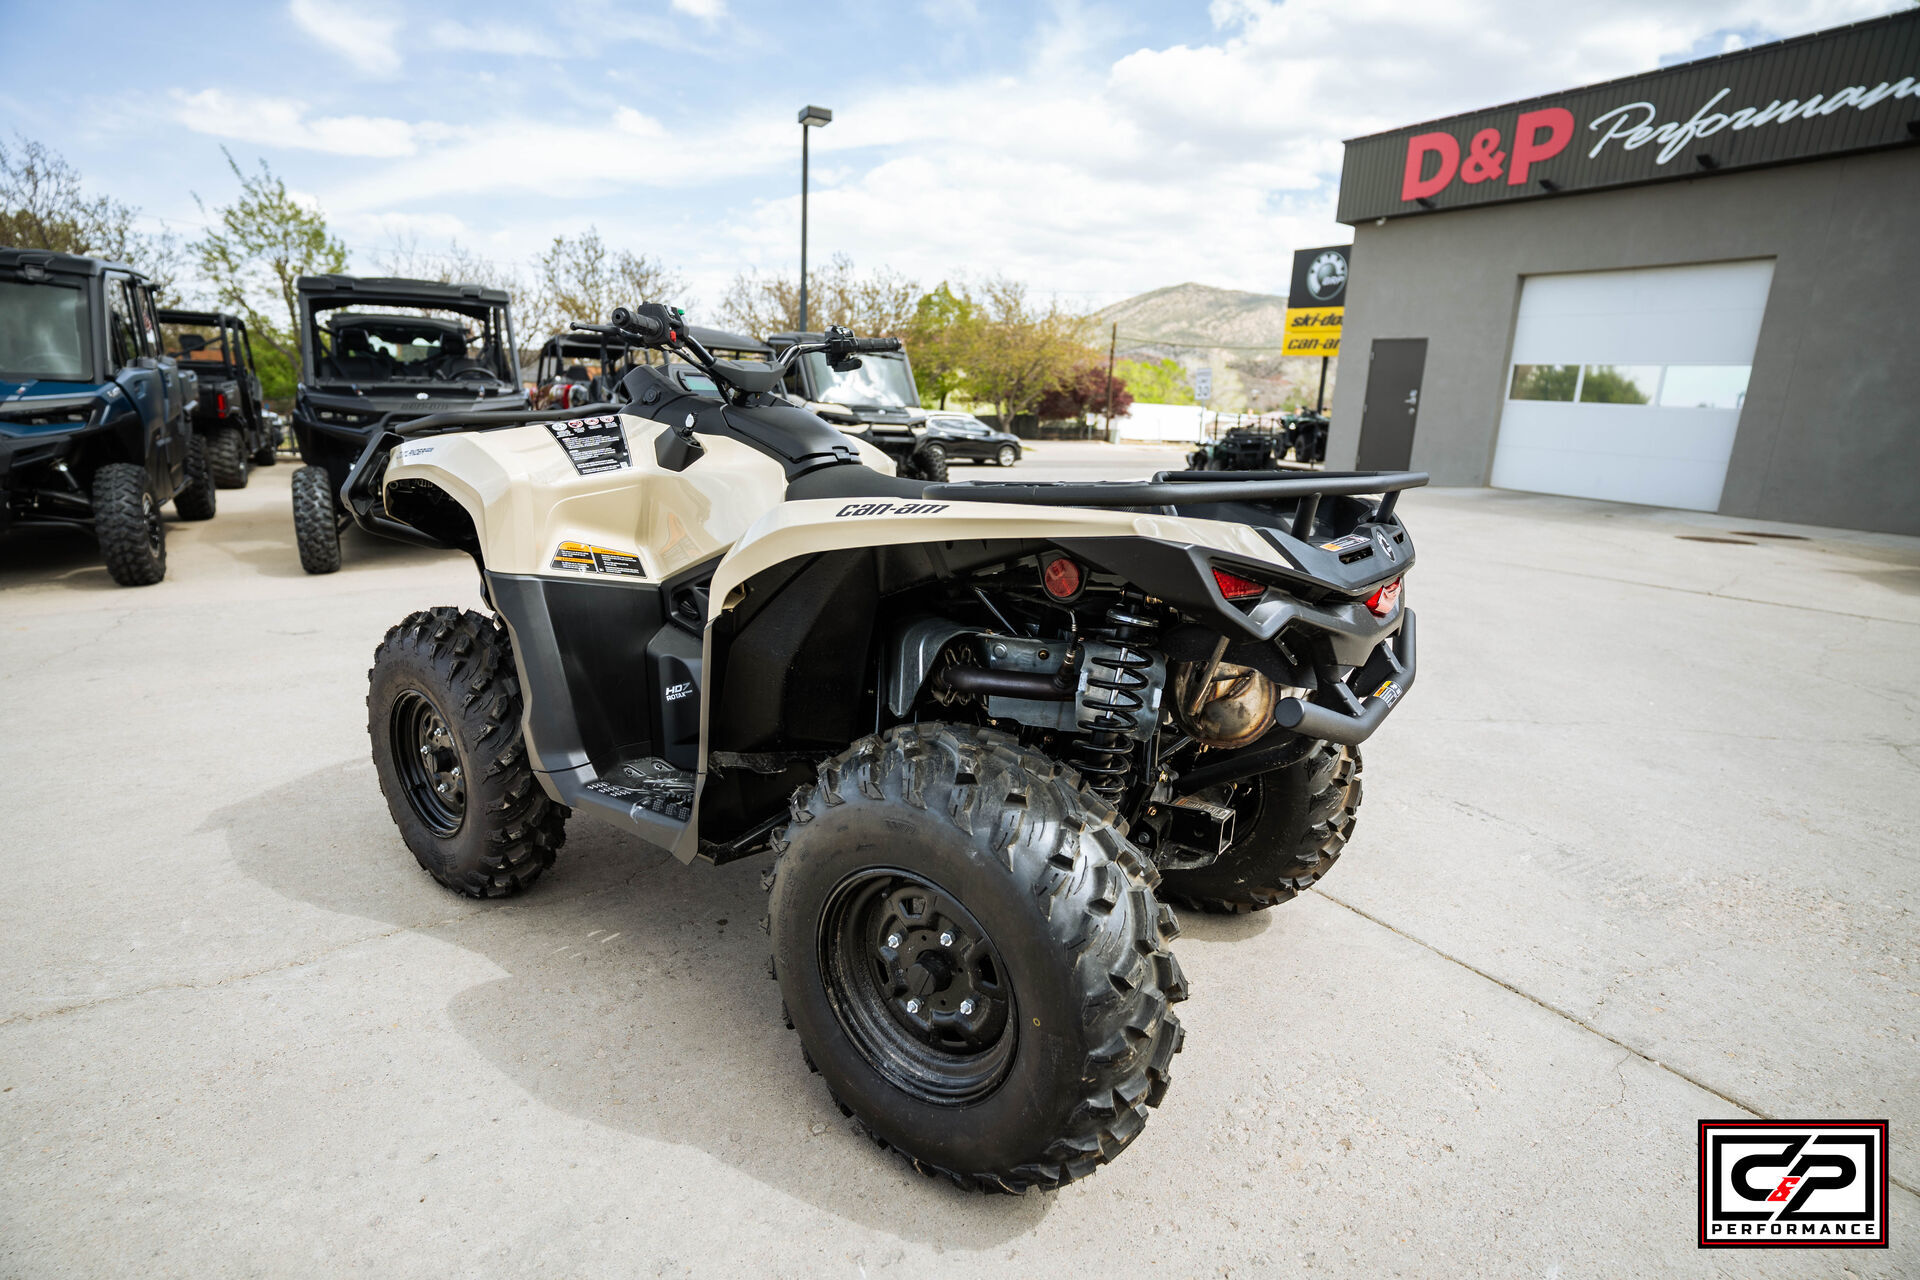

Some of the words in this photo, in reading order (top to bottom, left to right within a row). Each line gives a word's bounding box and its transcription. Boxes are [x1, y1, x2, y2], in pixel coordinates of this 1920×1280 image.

[1402, 108, 1575, 201] D&P
[1589, 76, 1920, 165] Performan
[1291, 313, 1343, 327] ski-do
[836, 503, 950, 517] can-am
[665, 682, 691, 695] HD7
